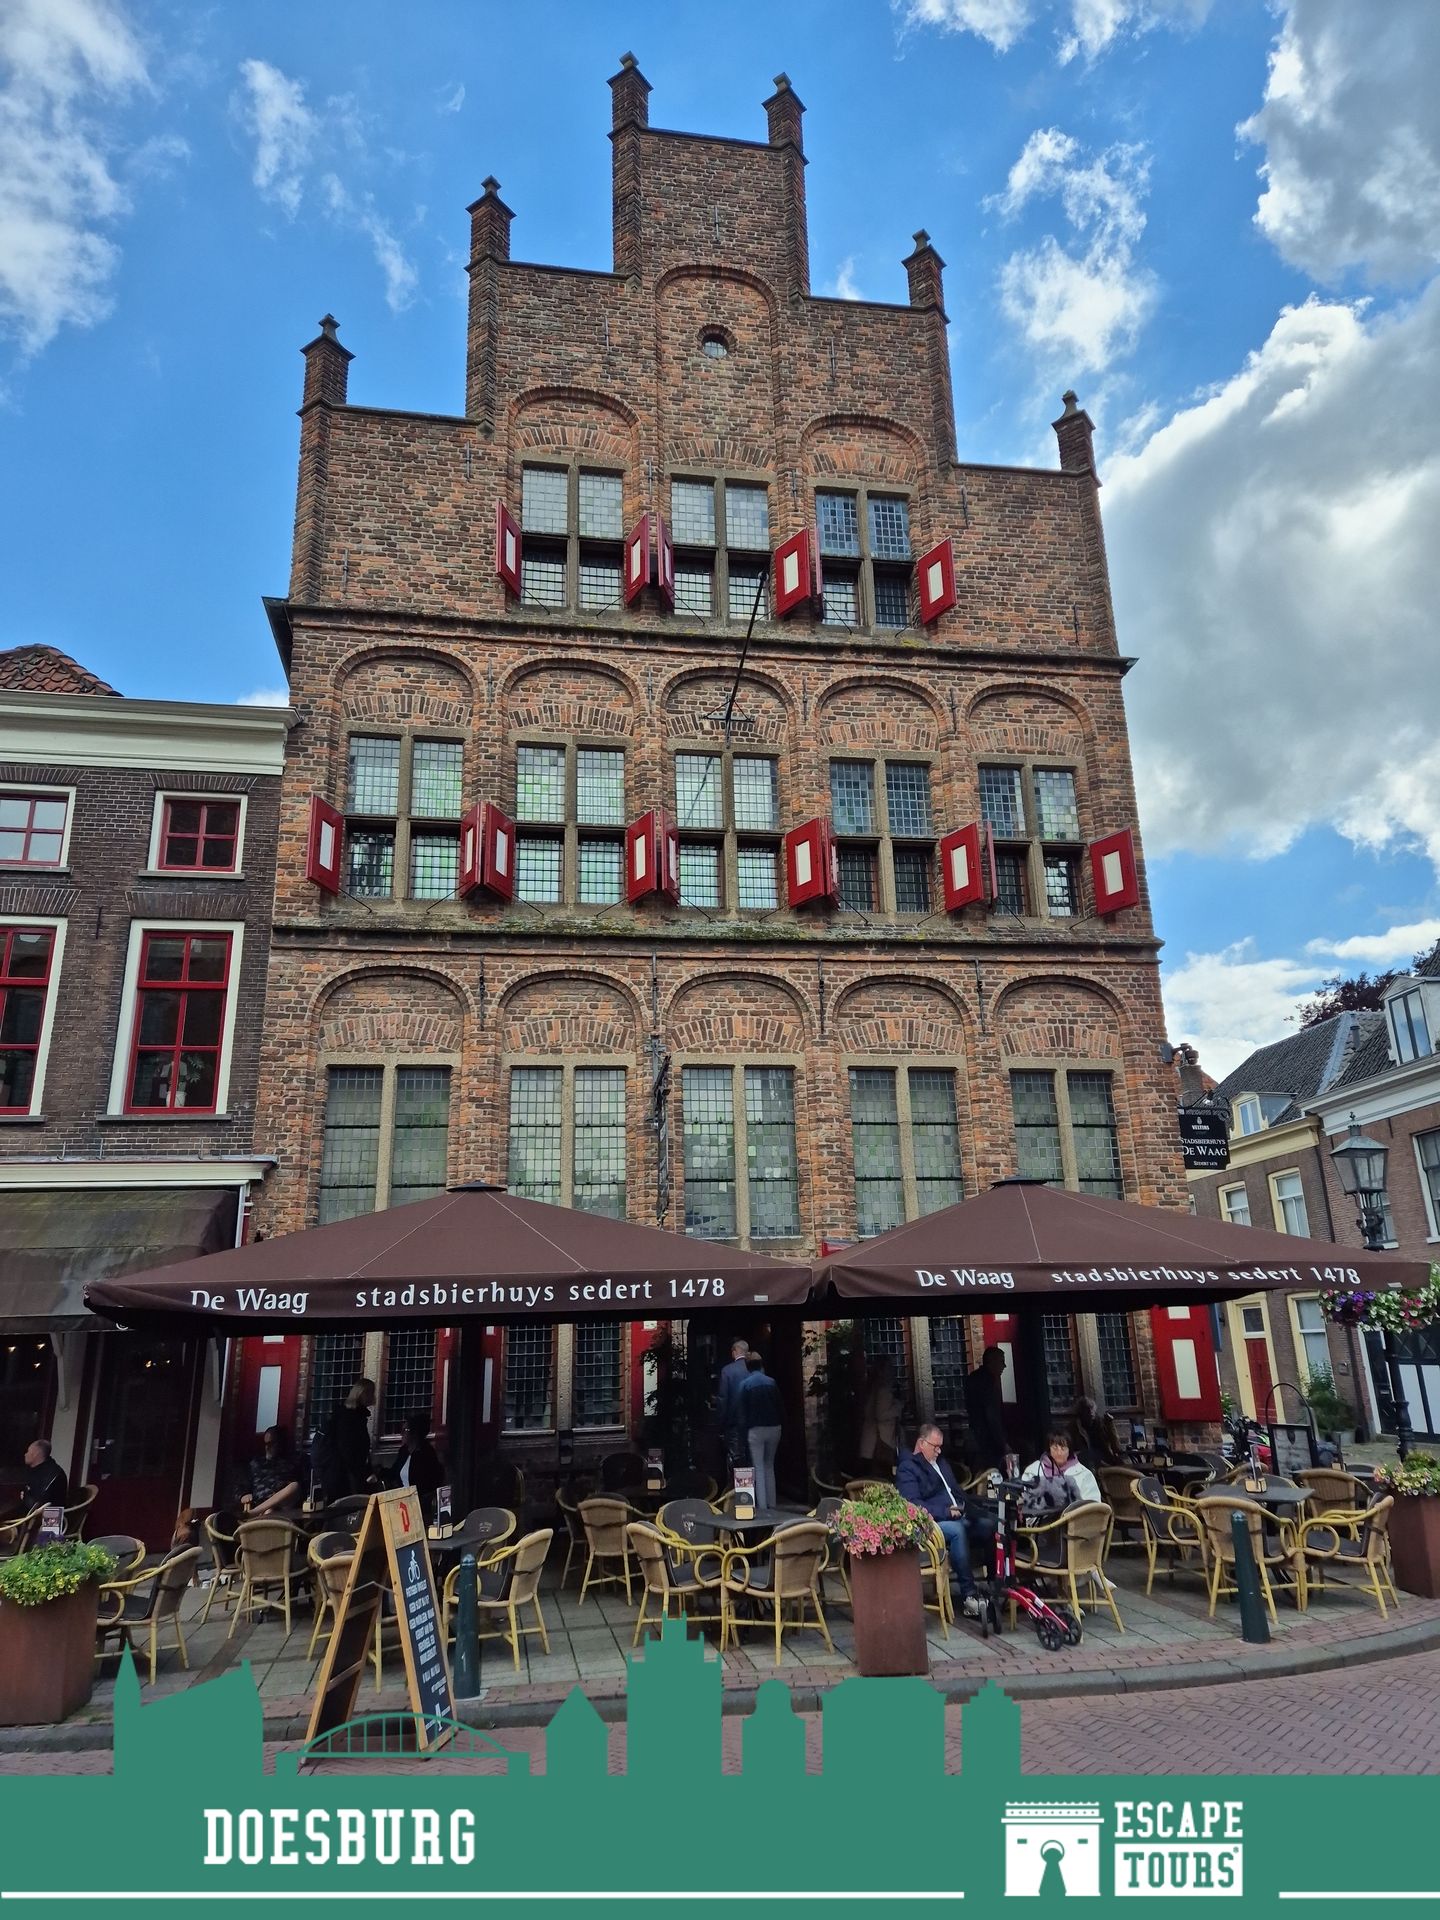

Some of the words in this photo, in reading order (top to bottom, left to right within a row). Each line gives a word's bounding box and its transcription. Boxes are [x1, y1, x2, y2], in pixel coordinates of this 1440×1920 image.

[1196, 1146, 1227, 1156] WAAG
[915, 1270, 945, 1285] De
[950, 1270, 1015, 1289] Waag
[1051, 1266, 1220, 1284] stadsbierhuys
[1228, 1266, 1303, 1282] sedert
[1310, 1267, 1361, 1285] 1478
[190, 1290, 225, 1311] De
[236, 1288, 310, 1315] Waag
[355, 1281, 554, 1308] stadsbierhuys
[569, 1278, 653, 1301] sedert
[669, 1278, 726, 1298] 1478
